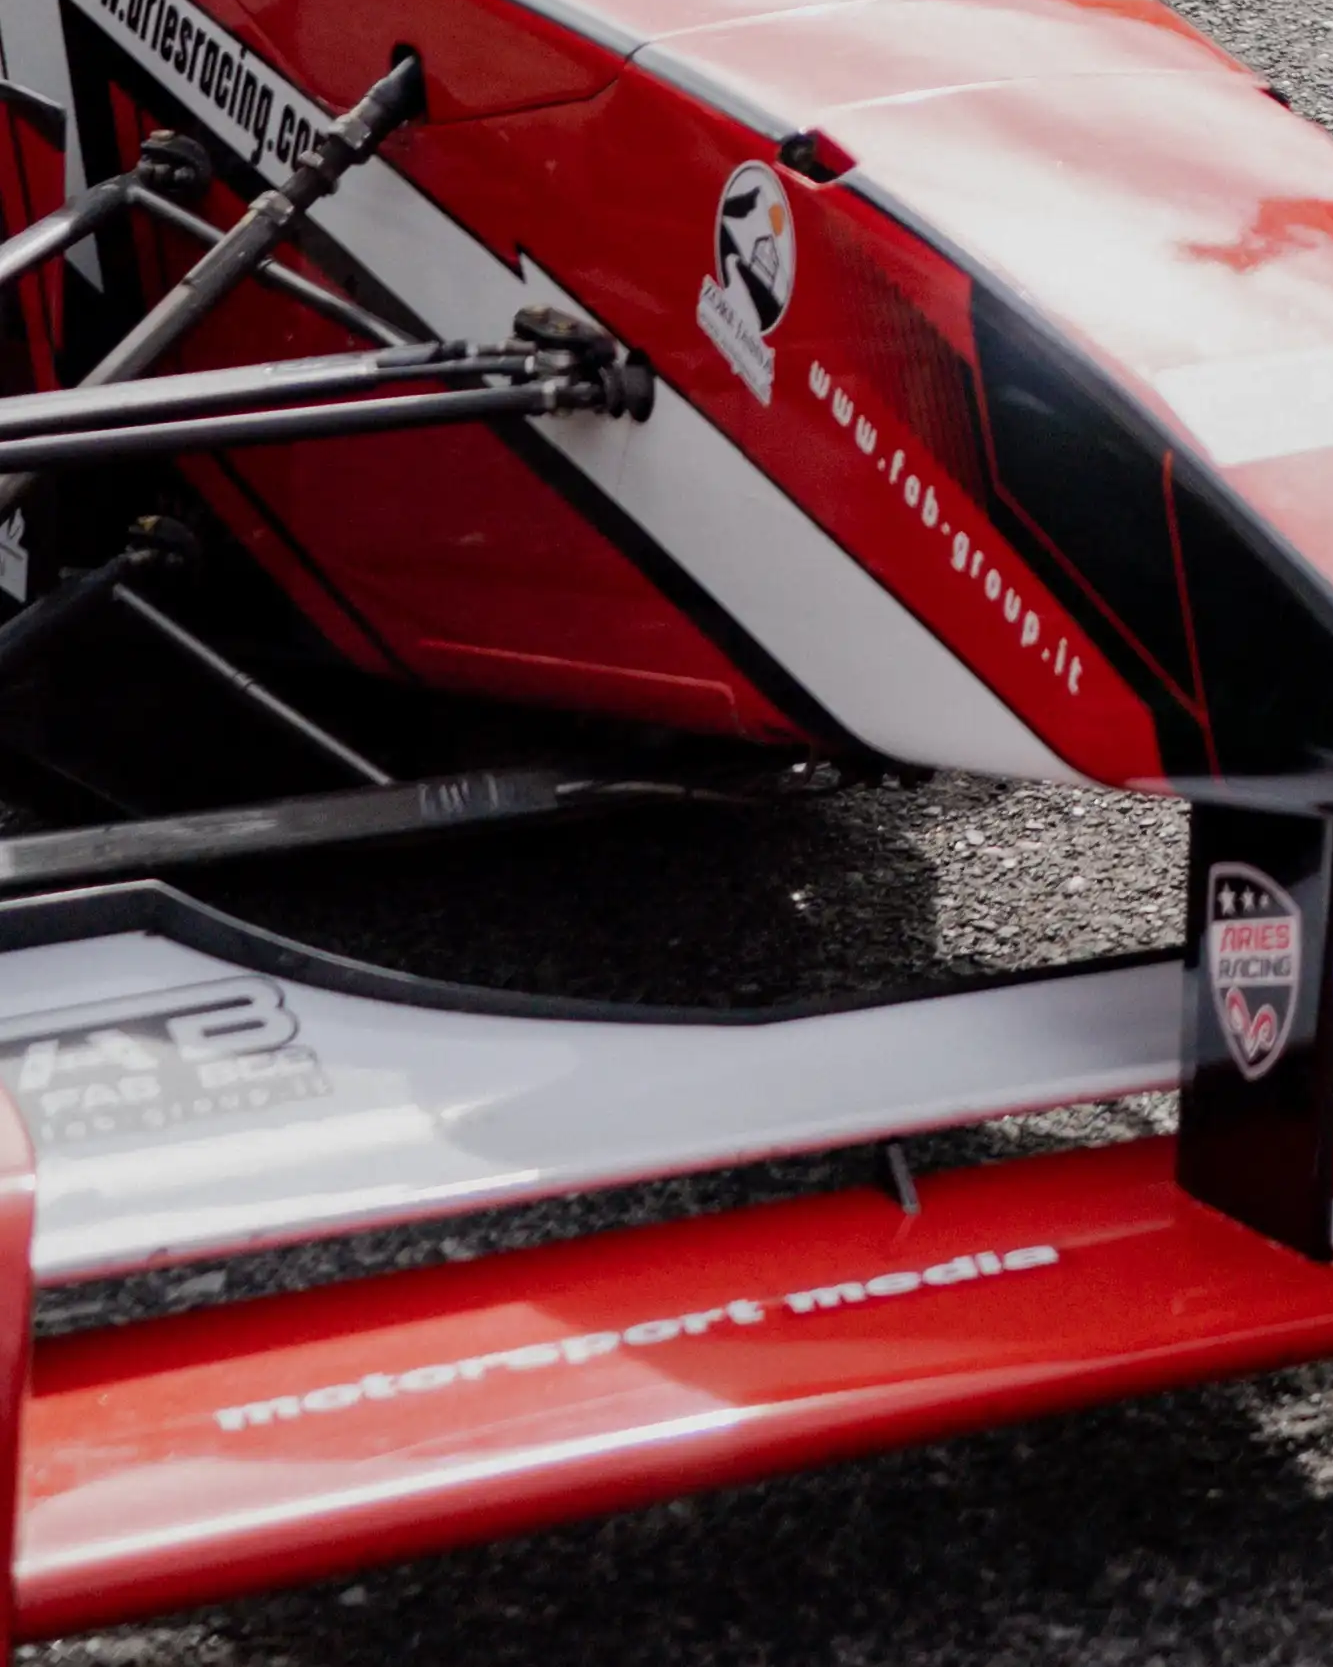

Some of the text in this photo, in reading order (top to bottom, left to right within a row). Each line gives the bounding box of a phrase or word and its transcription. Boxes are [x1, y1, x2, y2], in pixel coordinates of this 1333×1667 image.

[1219, 923, 1291, 953] ARIES
[1218, 955, 1292, 980] RACING
[214, 1243, 1059, 1431] motorsport media
